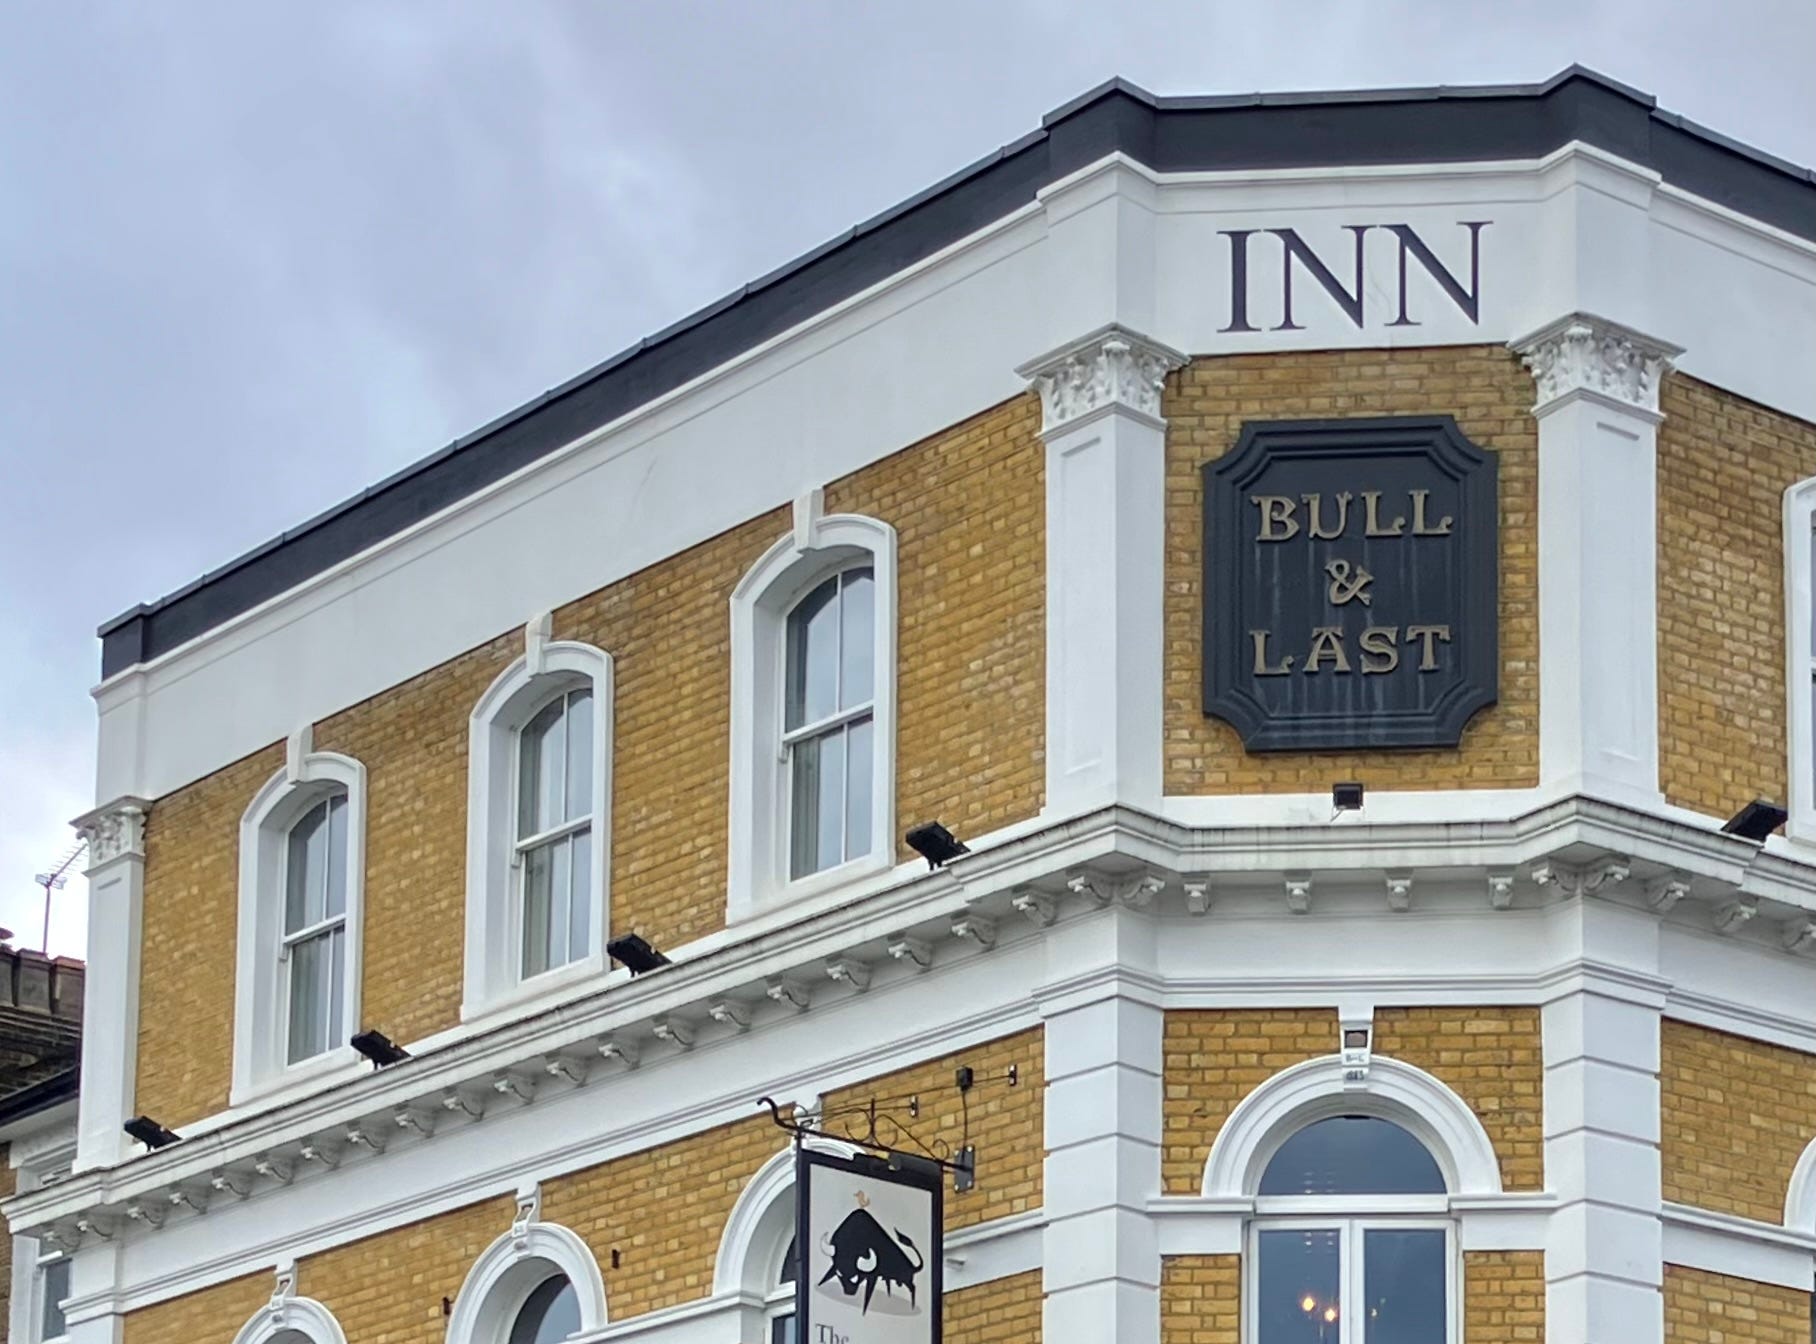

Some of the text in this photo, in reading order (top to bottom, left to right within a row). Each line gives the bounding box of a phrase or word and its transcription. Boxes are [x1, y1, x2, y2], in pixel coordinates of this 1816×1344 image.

[1217, 220, 1494, 333] INN
[1251, 490, 1453, 543] BULL
[1325, 560, 1374, 607] &
[1249, 626, 1451, 676] LAST
